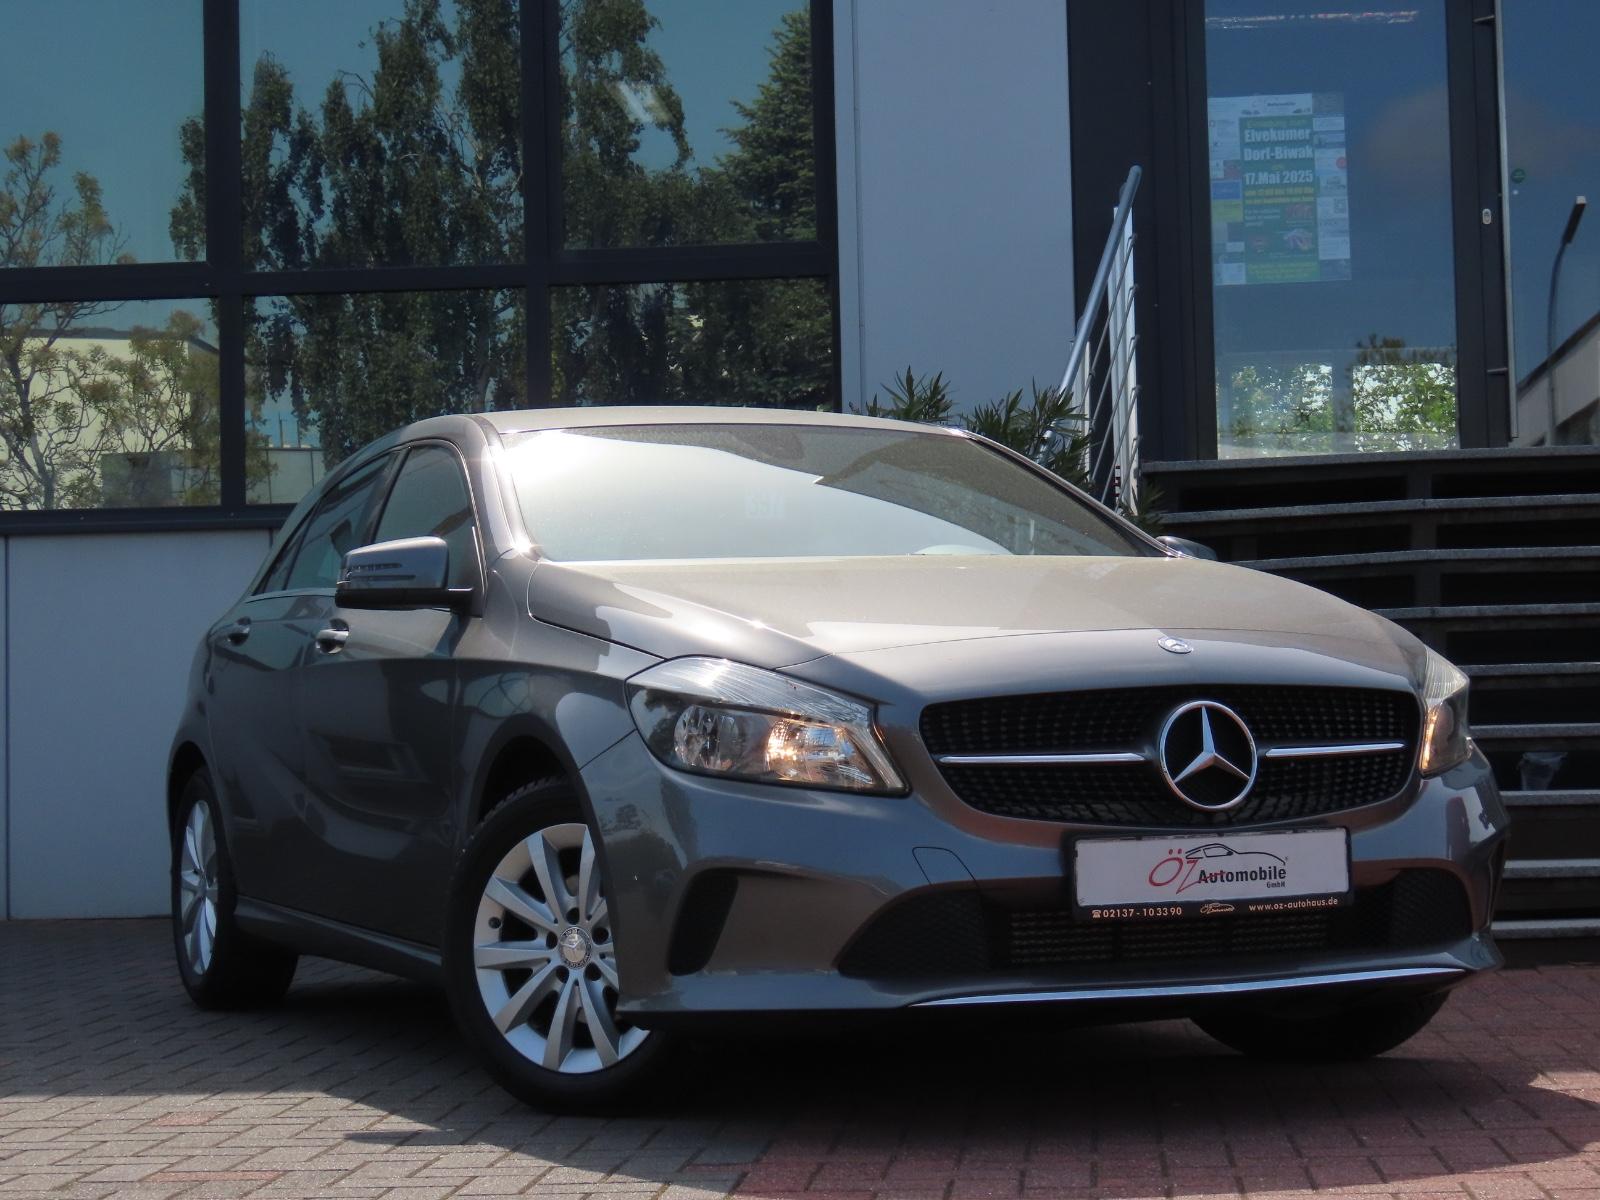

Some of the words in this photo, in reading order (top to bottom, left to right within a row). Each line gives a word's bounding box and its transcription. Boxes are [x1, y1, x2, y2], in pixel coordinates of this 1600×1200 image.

[1244, 146, 1314, 160] Dorf-Biwak
[1282, 169, 1314, 183] 2025
[1198, 865, 1287, 884] Automobile
[1248, 897, 1339, 912] www.oz-autohaus.de
